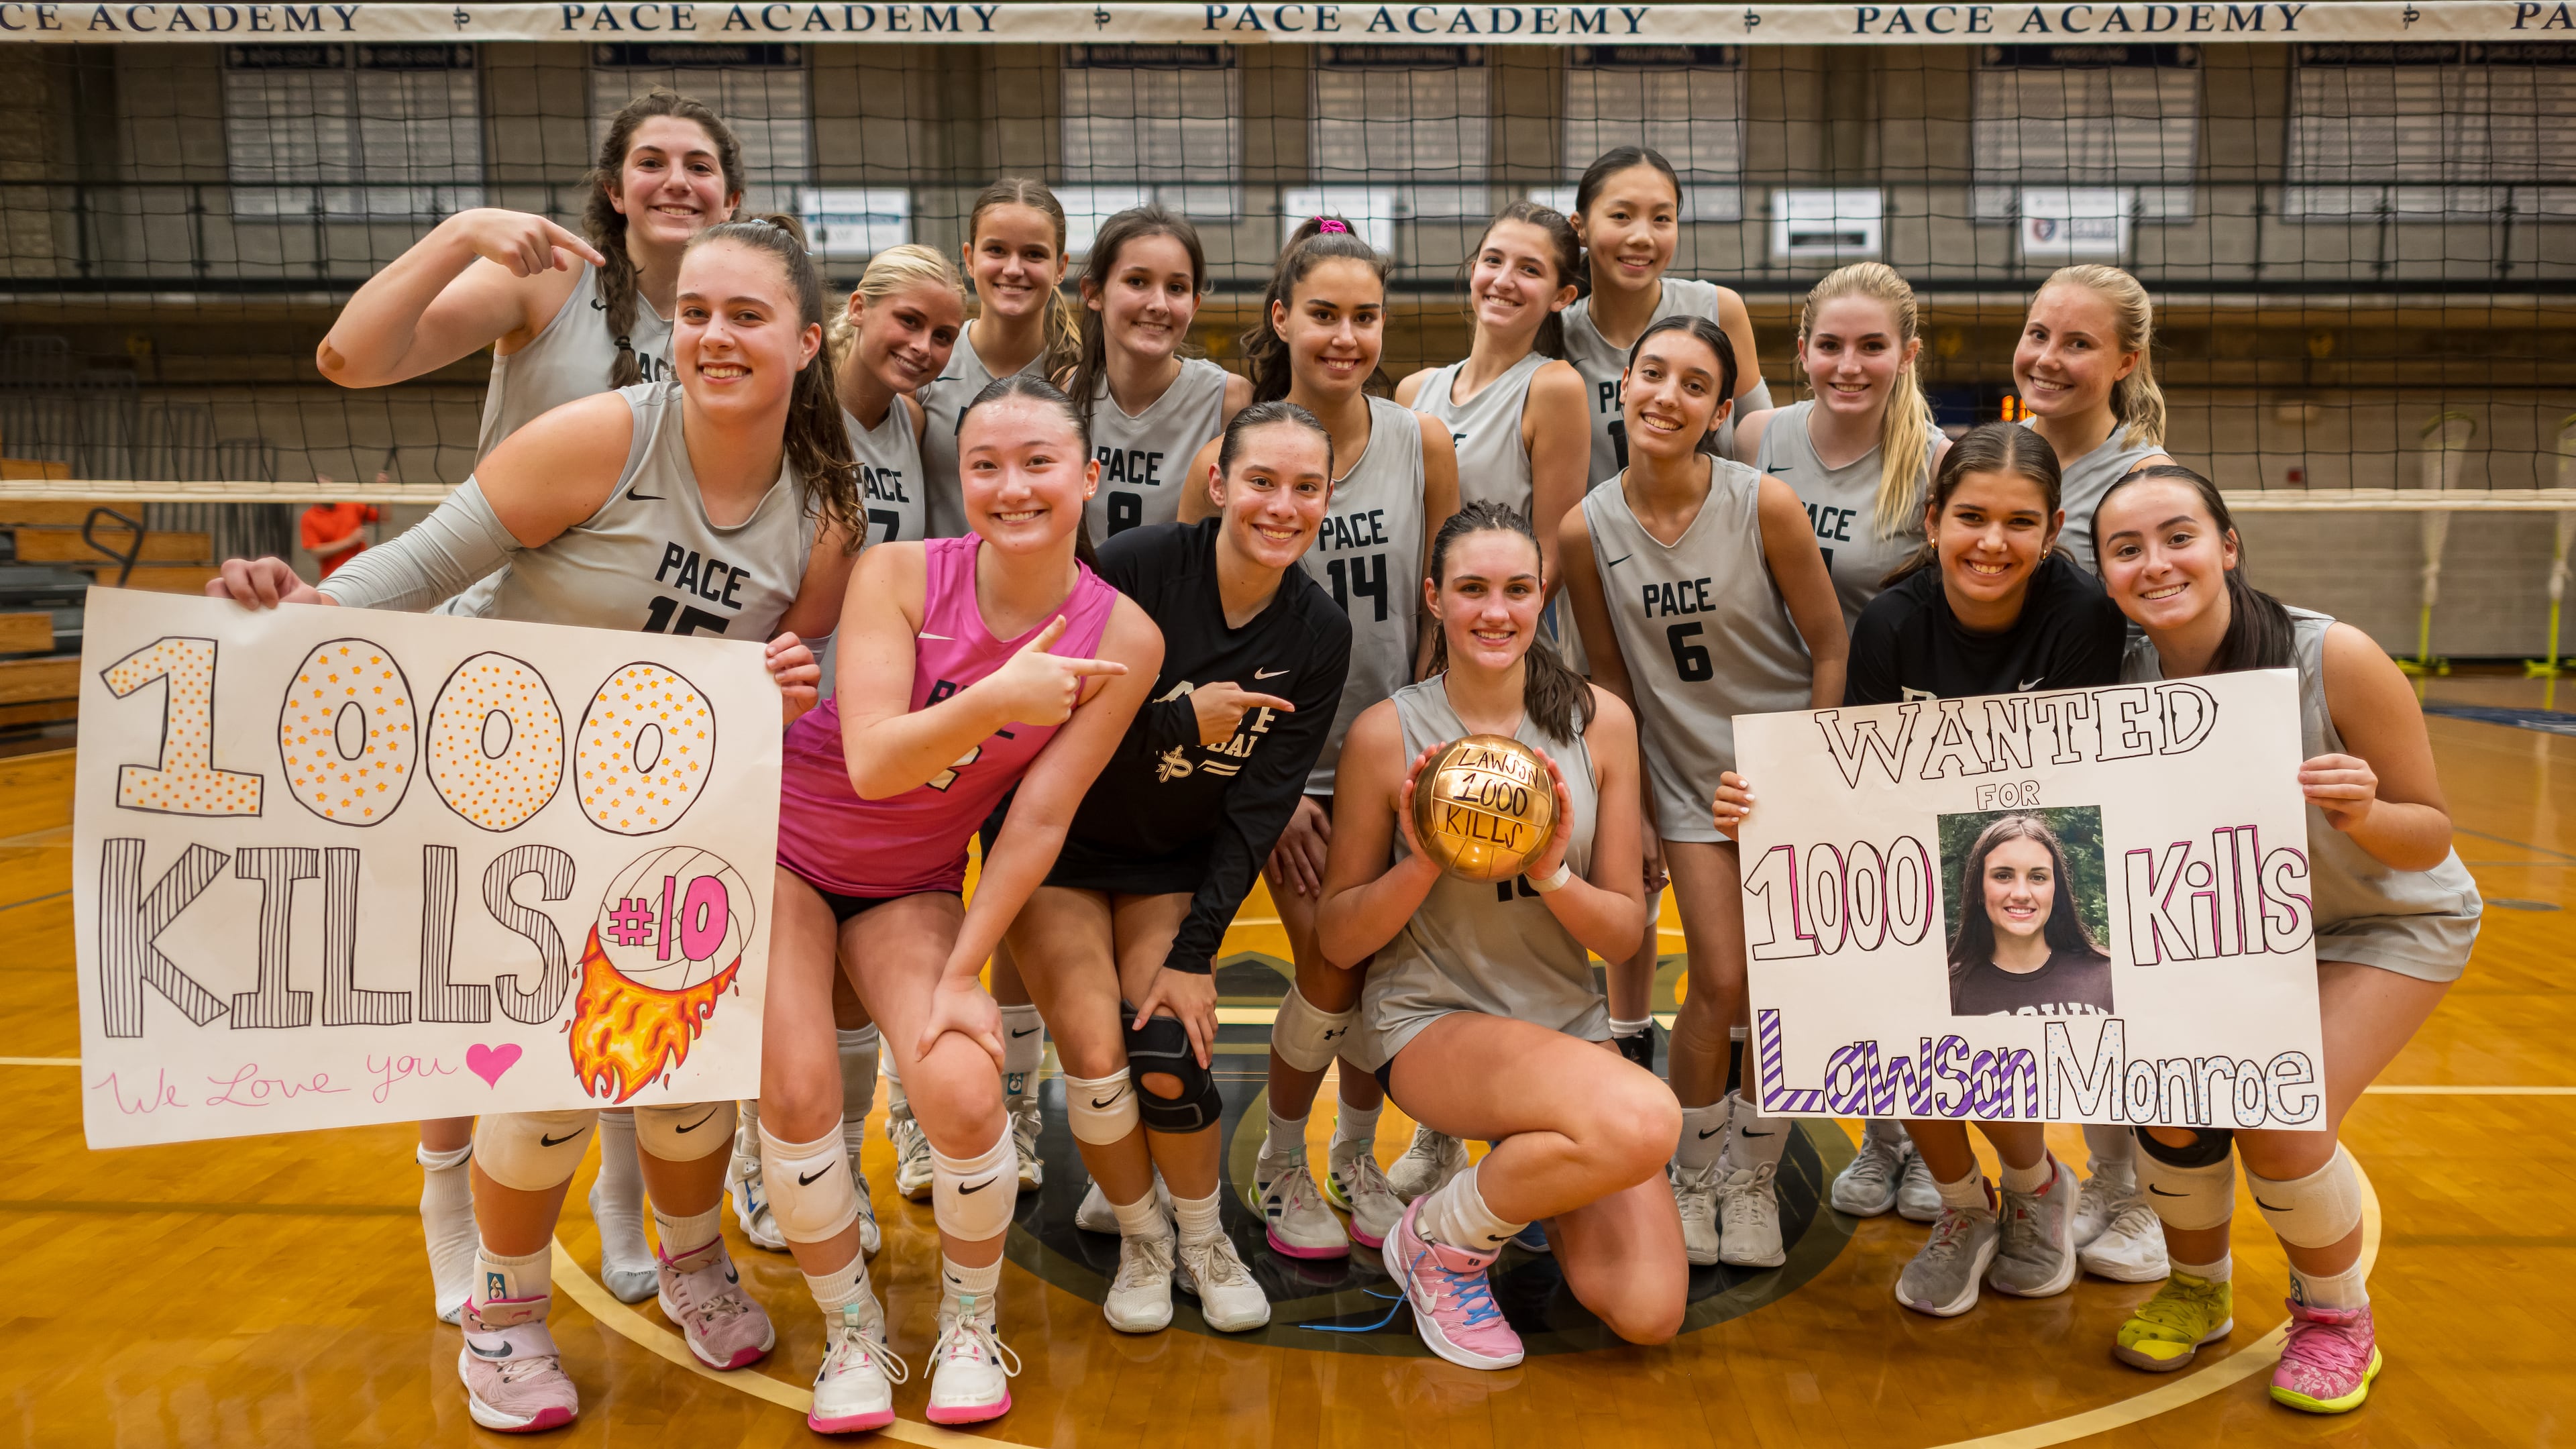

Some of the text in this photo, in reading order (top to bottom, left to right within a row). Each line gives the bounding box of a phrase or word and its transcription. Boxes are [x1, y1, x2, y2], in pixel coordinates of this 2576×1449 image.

[87, 4, 363, 32] ACADEMY
[559, 4, 1002, 32] PACE ACADEMY
[1201, 4, 1650, 34] PACE ACADEMY
[1852, 4, 2308, 34] PACE ACADEMY
[2510, 2, 2576, 30] PA
[1097, 445, 1164, 486] PACE
[1318, 508, 1389, 551] PACE
[1801, 501, 1857, 542] ACE
[655, 541, 751, 610] PACE
[1326, 553, 1388, 622] 14
[1642, 577, 1717, 619] PACE
[1666, 621, 1714, 682] 6
[100, 636, 716, 837] 1000
[1814, 682, 2219, 790] WANTED
[1458, 747, 1539, 789] LAWSON
[1453, 773, 1528, 817] 1000
[1976, 780, 2041, 811] FOR
[1446, 804, 1523, 849] KILLS
[1743, 824, 2314, 967] 1000 Kills
[99, 838, 576, 1038] KILLS
[608, 875, 729, 962] #10
[91, 1054, 458, 1114] We Love you
[1758, 1008, 2320, 1128] Lawson Monroe
